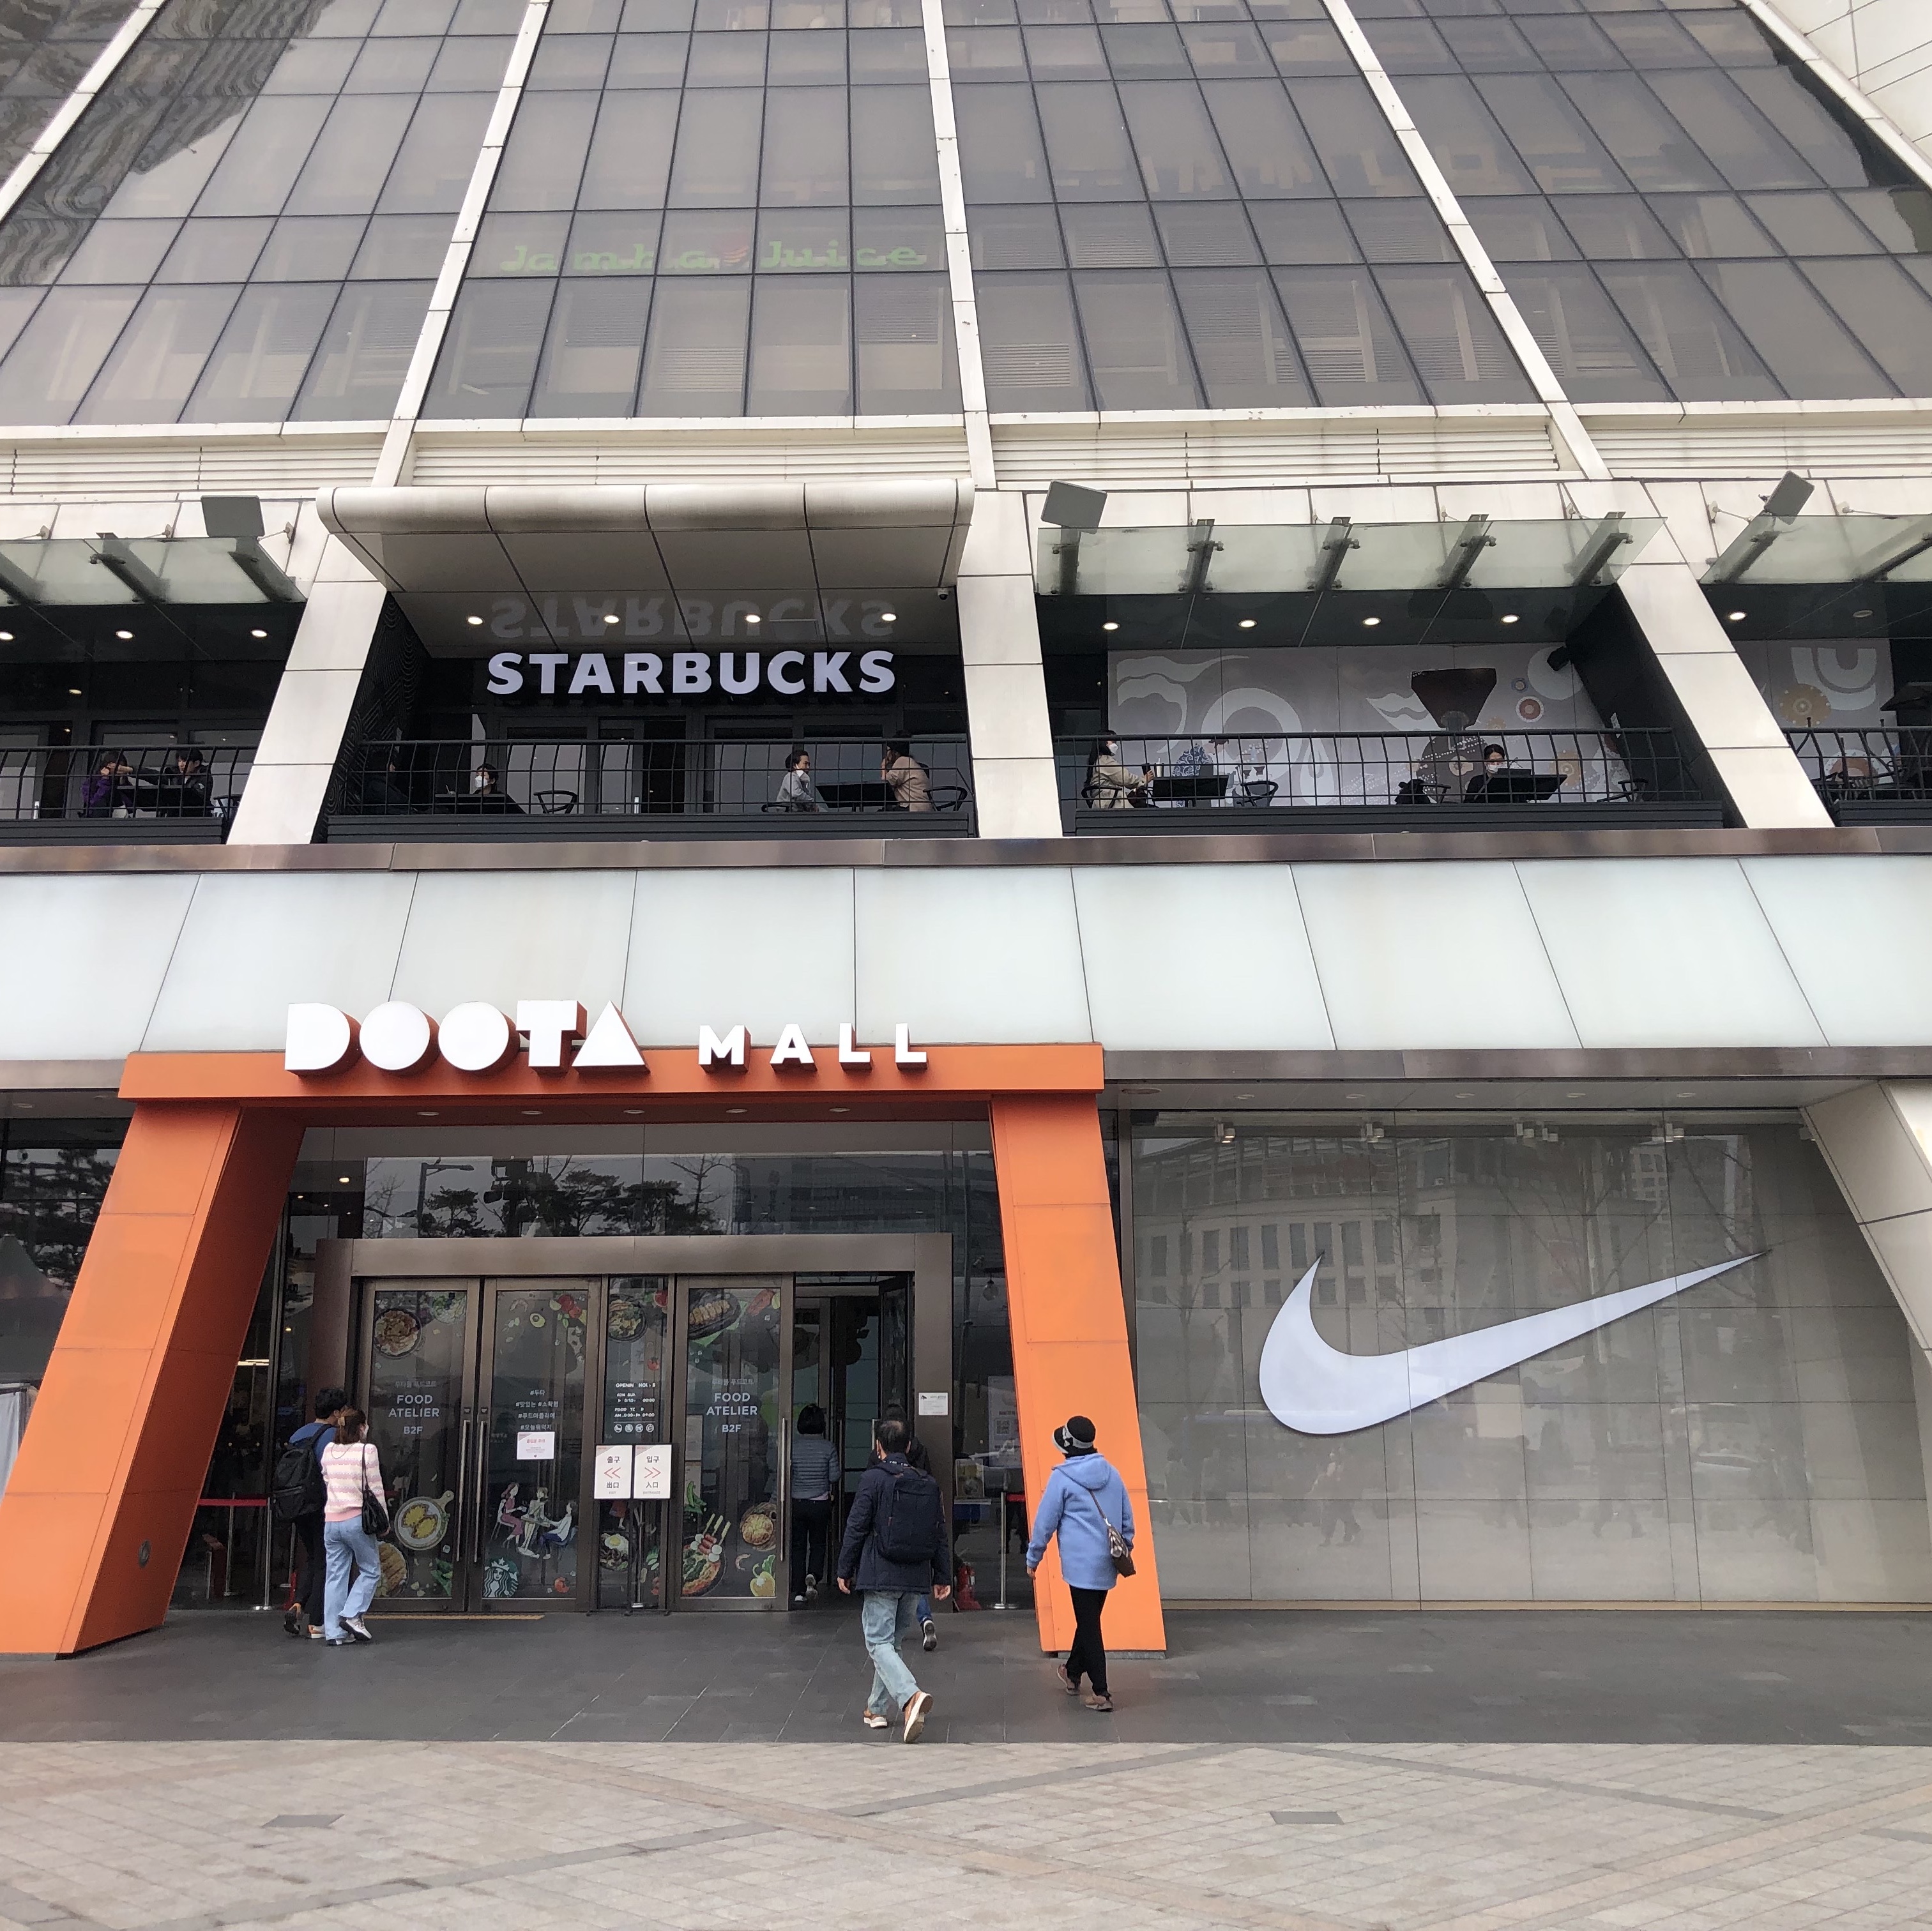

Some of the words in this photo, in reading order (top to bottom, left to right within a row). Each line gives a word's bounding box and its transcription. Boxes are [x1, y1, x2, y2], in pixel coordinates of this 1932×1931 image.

[760, 239, 927, 267] Juice
[487, 651, 894, 695] STARBUCKS
[285, 999, 646, 1073] DOOTA
[698, 1022, 927, 1069] MALL
[397, 1395, 433, 1404] FOOD
[714, 1392, 750, 1402] FOOD
[388, 1407, 440, 1418] ATELIER
[706, 1405, 758, 1416] ATELIER
[403, 1426, 423, 1435] B2F
[722, 1424, 742, 1433] B2F
